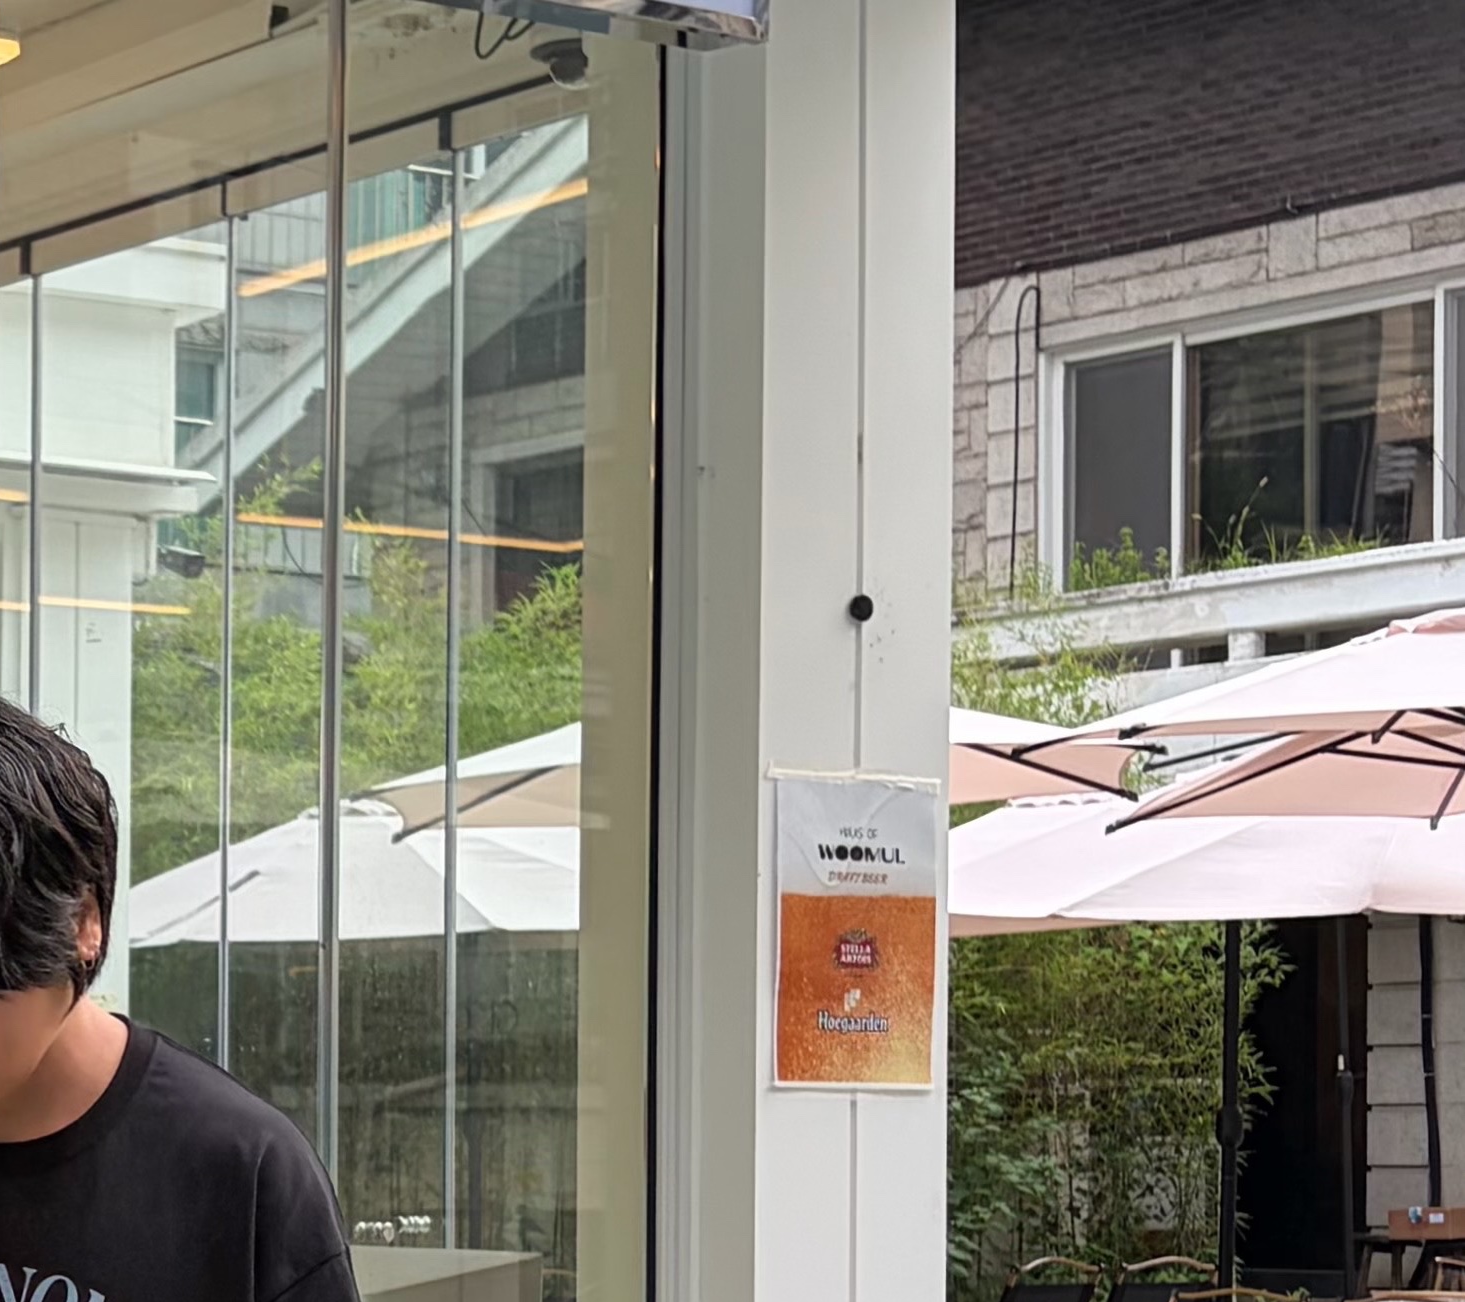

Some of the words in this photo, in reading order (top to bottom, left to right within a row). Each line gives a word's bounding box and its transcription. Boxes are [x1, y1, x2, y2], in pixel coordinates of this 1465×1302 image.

[818, 843, 906, 865] WOOMUL
[840, 943, 871, 954] STELLA
[840, 954, 872, 965] ARTOIS
[817, 1009, 890, 1034] Hoegaarden
